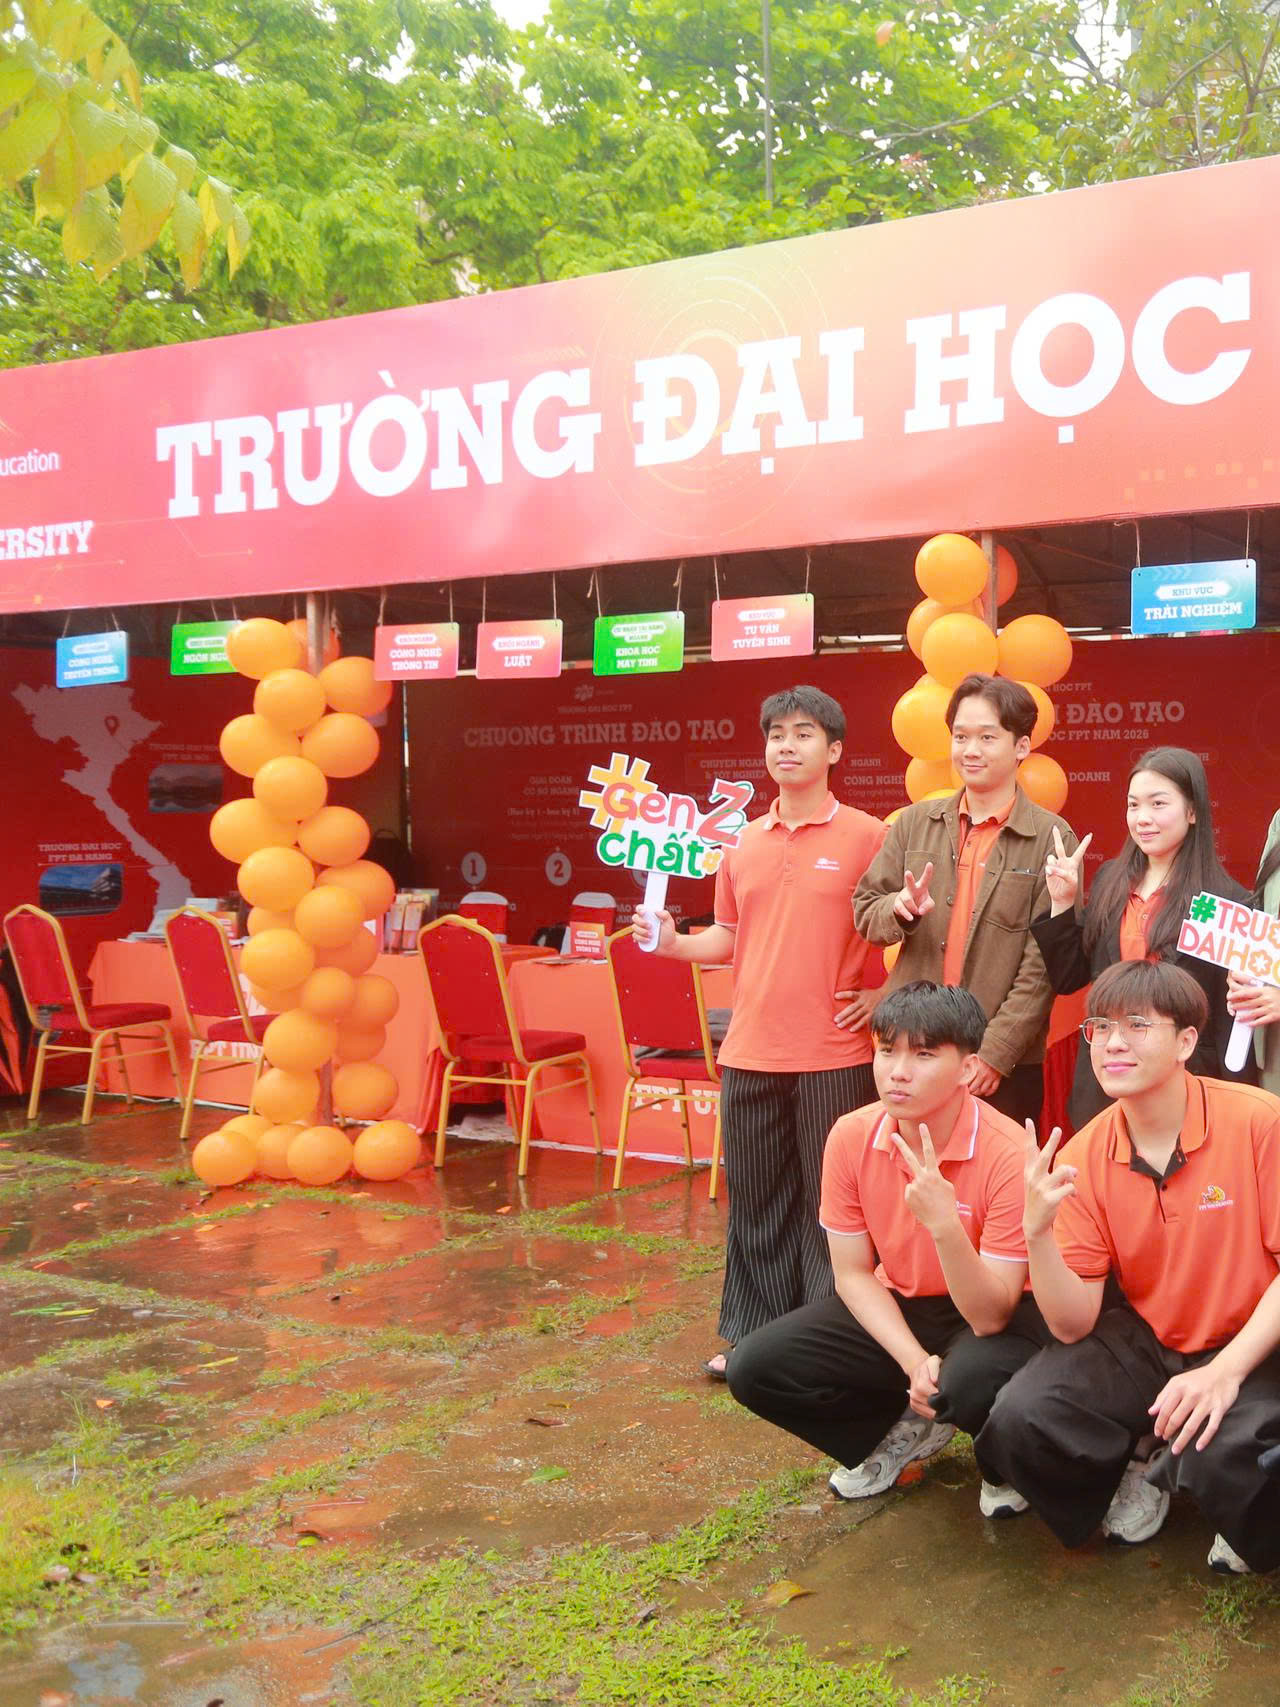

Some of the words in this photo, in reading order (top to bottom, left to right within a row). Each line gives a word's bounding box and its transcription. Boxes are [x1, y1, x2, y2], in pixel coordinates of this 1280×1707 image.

[157, 370, 601, 518] TRƯỜNG
[634, 326, 865, 475] ĐẠI
[904, 269, 1251, 442] HỌC
[1066, 698, 1124, 724] ĐÀO
[1130, 701, 1185, 727] TẠO
[1068, 730, 1090, 741] FPT
[1069, 772, 1111, 782] DOANH
[599, 830, 704, 877] chất
[469, 860, 478, 877] 1
[553, 860, 565, 878] 2
